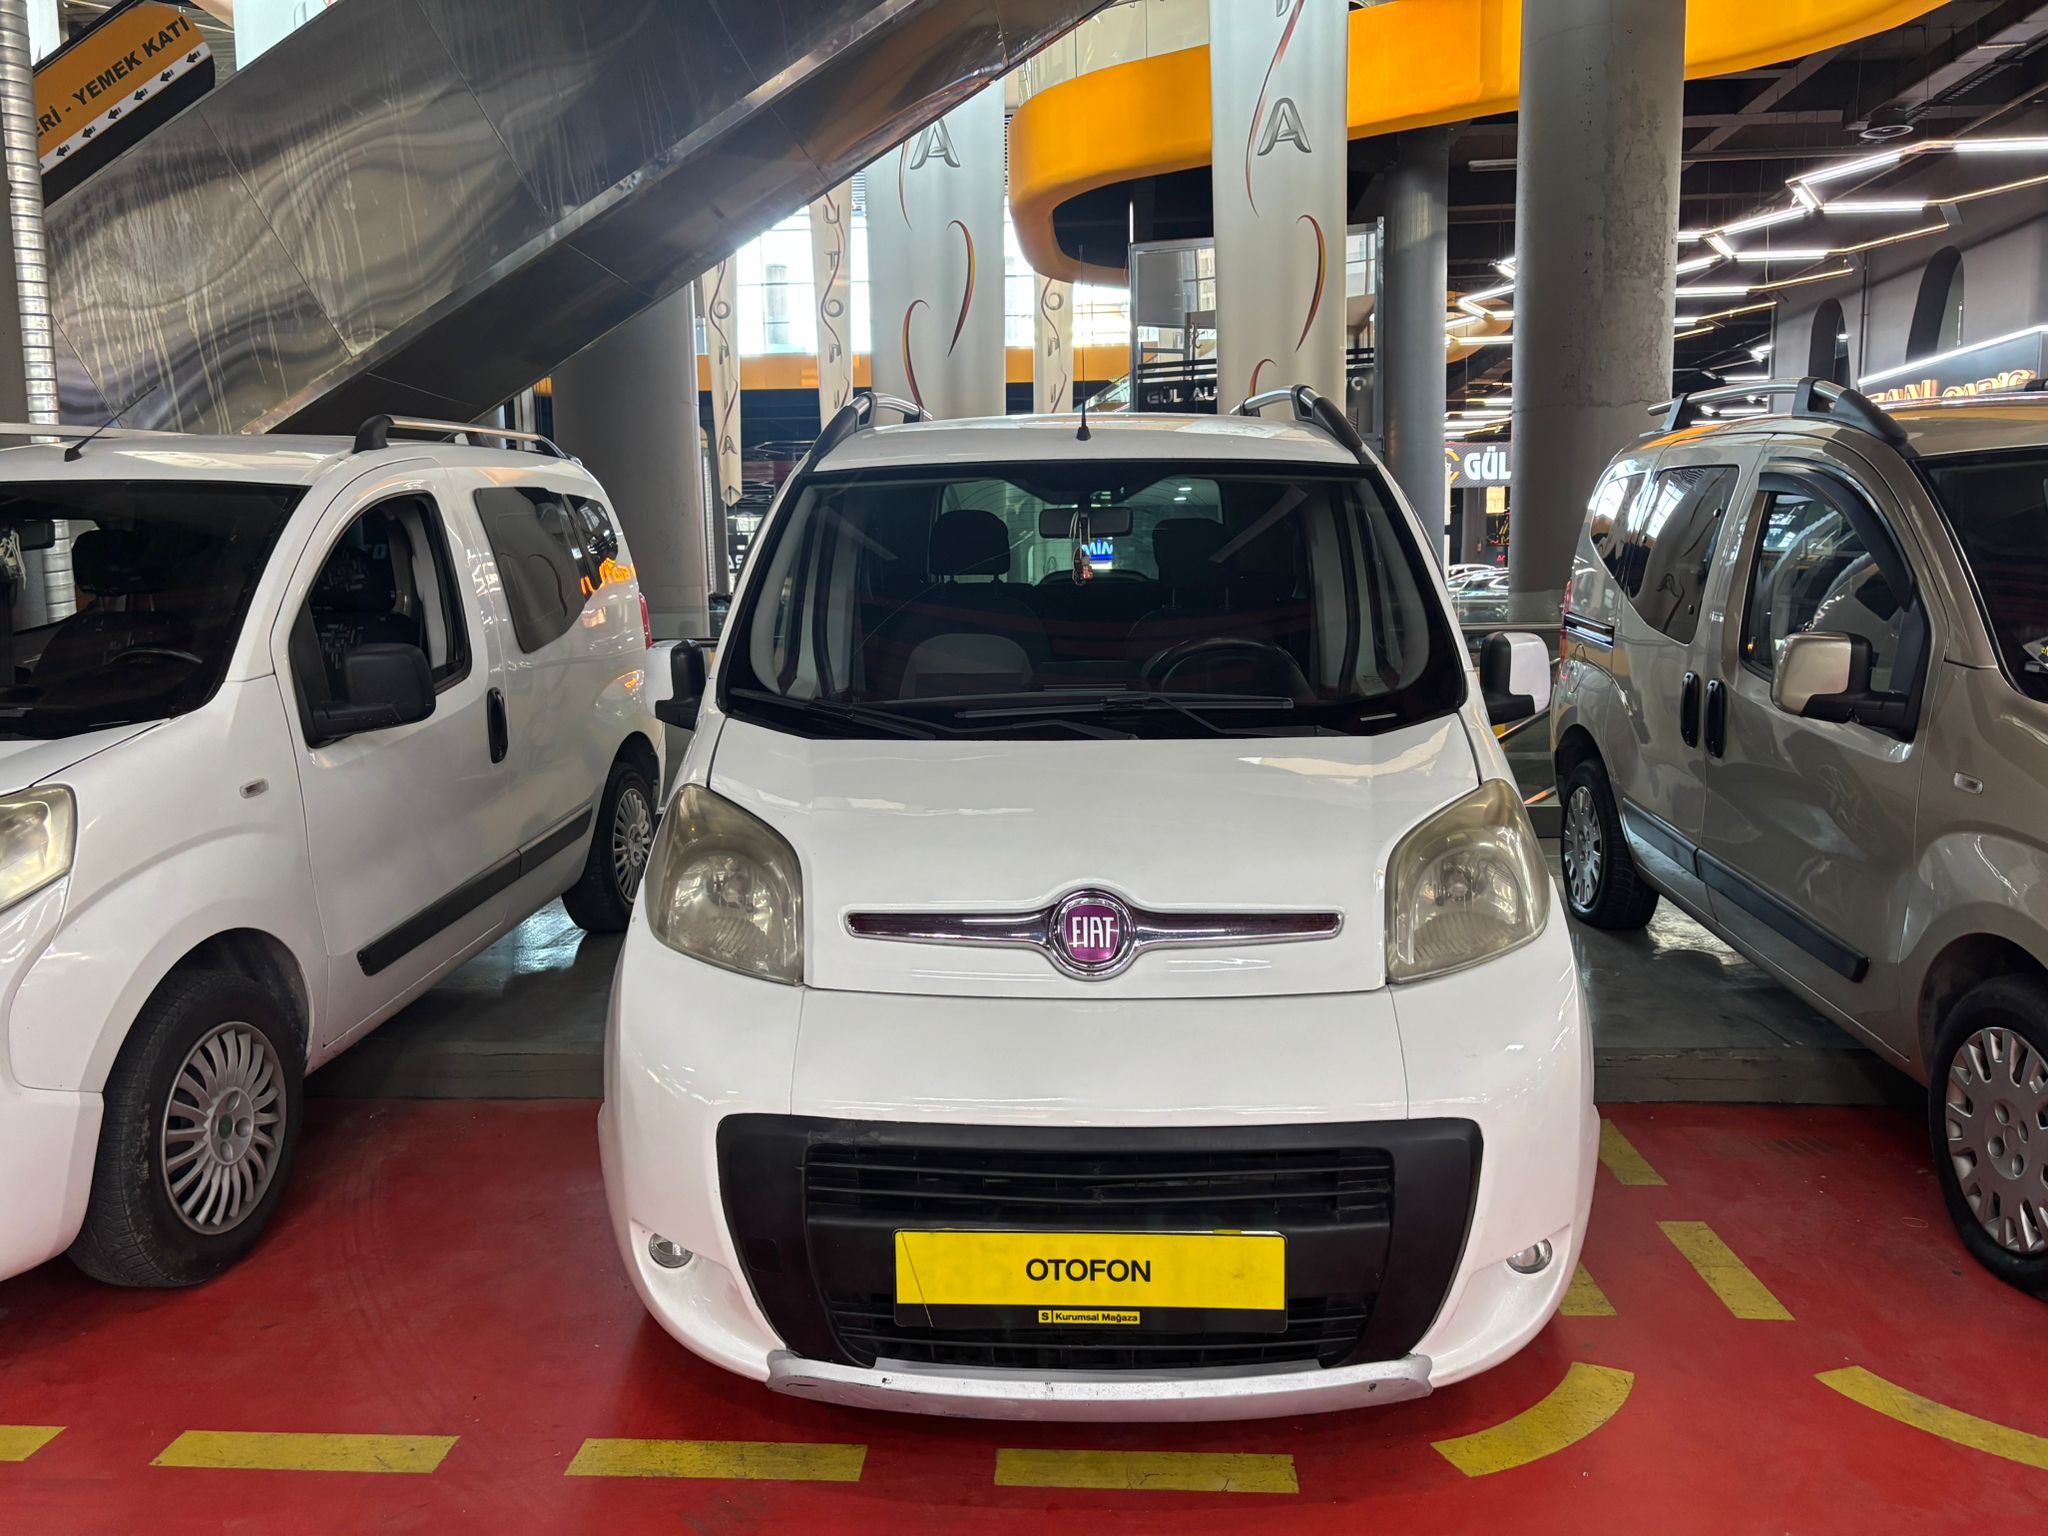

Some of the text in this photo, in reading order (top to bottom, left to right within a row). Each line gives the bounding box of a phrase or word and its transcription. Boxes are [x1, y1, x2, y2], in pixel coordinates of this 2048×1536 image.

[72, 51, 143, 106] YEMEK
[141, 16, 190, 58] KATI
[1147, 386, 1184, 404] GÜL
[1464, 446, 1512, 480] GÜL
[1072, 916, 1115, 948] FIAT
[1025, 1258, 1151, 1283] OTOFON
[1041, 1312, 1138, 1323] S Kurumsal Mağaza
